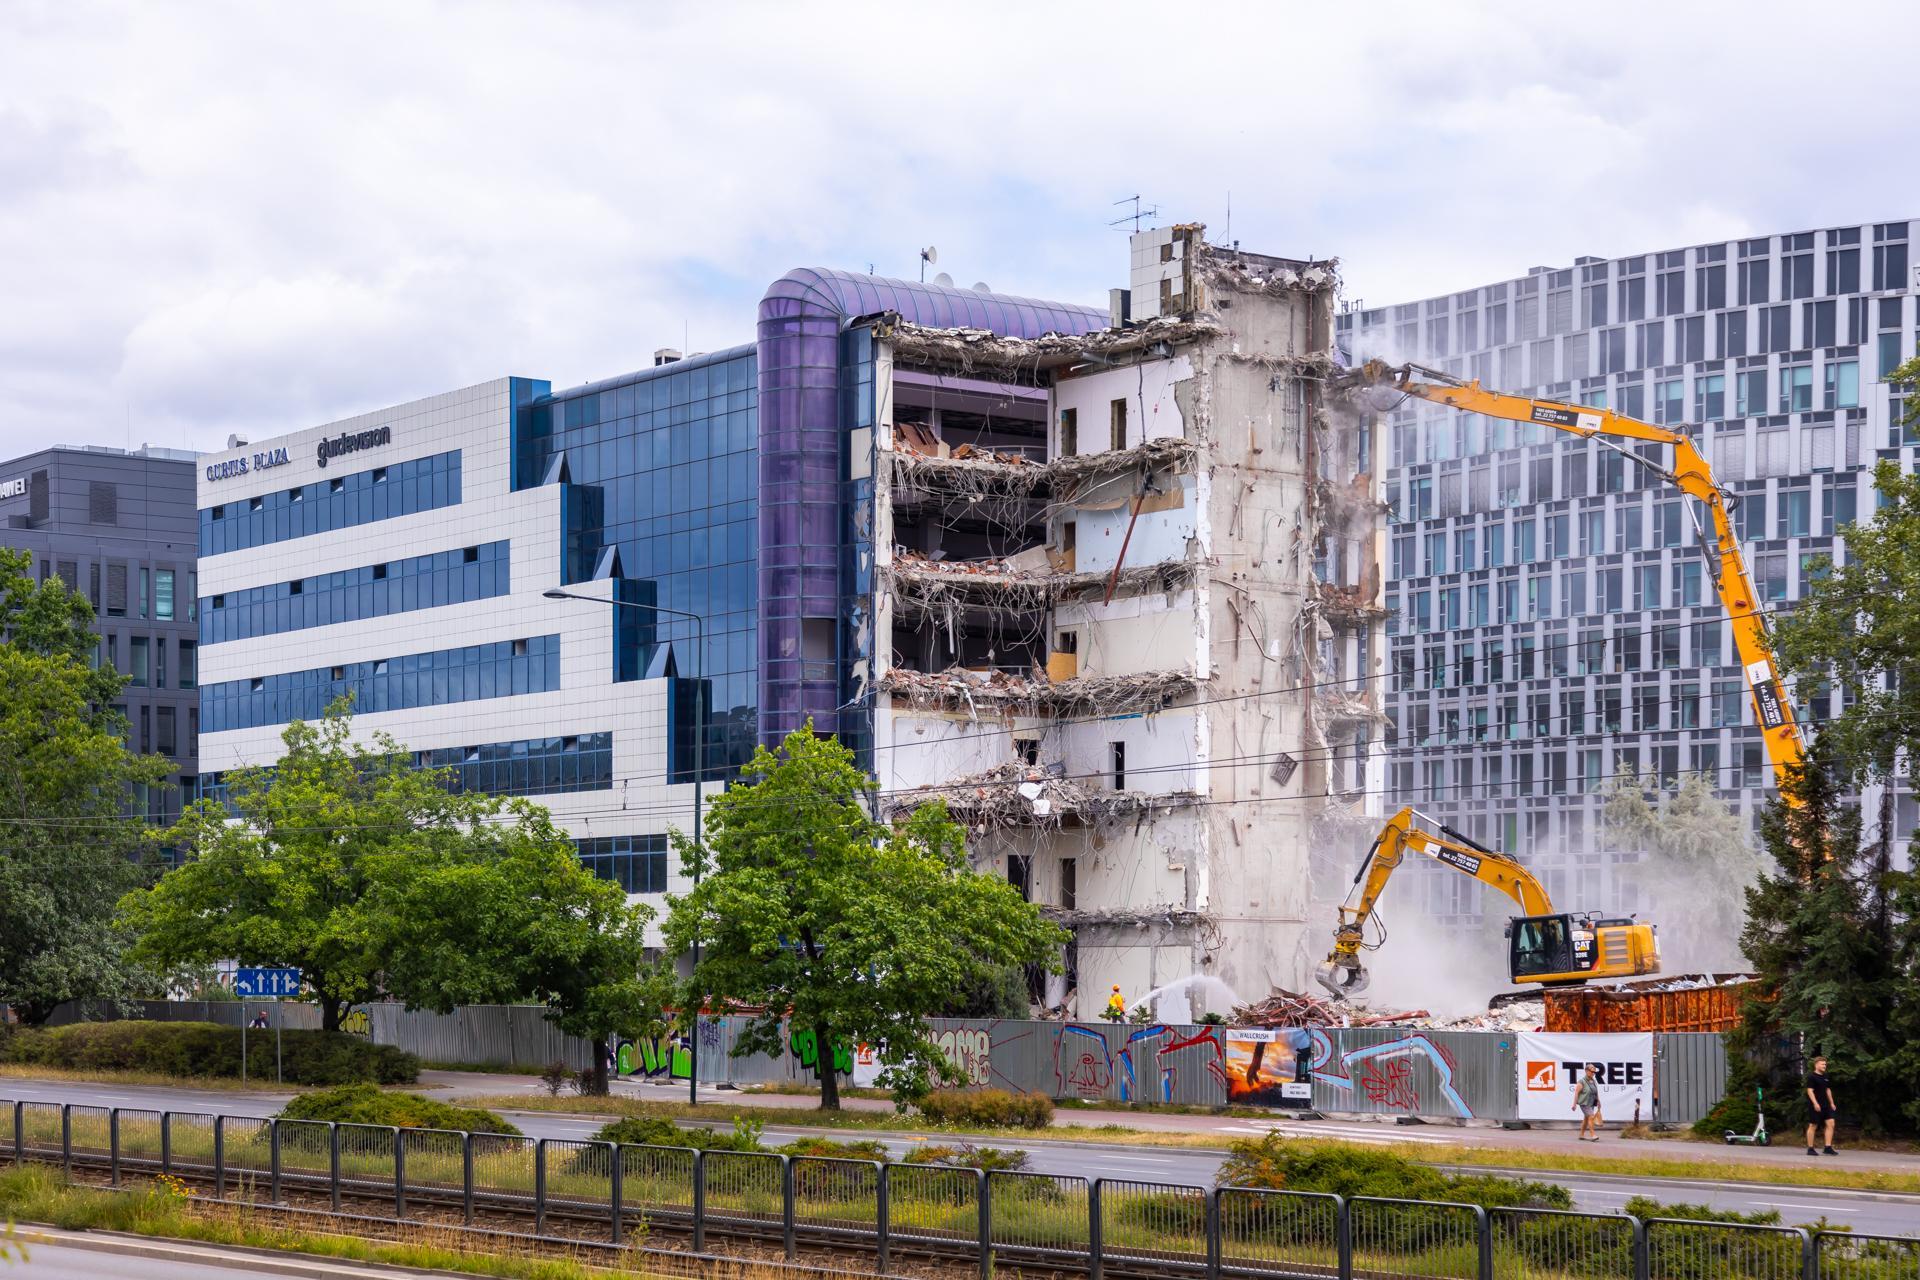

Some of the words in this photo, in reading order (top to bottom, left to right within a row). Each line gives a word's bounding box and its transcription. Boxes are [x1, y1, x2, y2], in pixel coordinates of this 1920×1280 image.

[317, 426, 391, 467] guidevision
[206, 456, 249, 481] CURTIS
[253, 447, 291, 471] PLAZA
[0, 478, 26, 499] AWEI
[1574, 941, 1590, 951] CAT
[1562, 1061, 1643, 1085] TREE
[1569, 1085, 1643, 1093] GUPA
